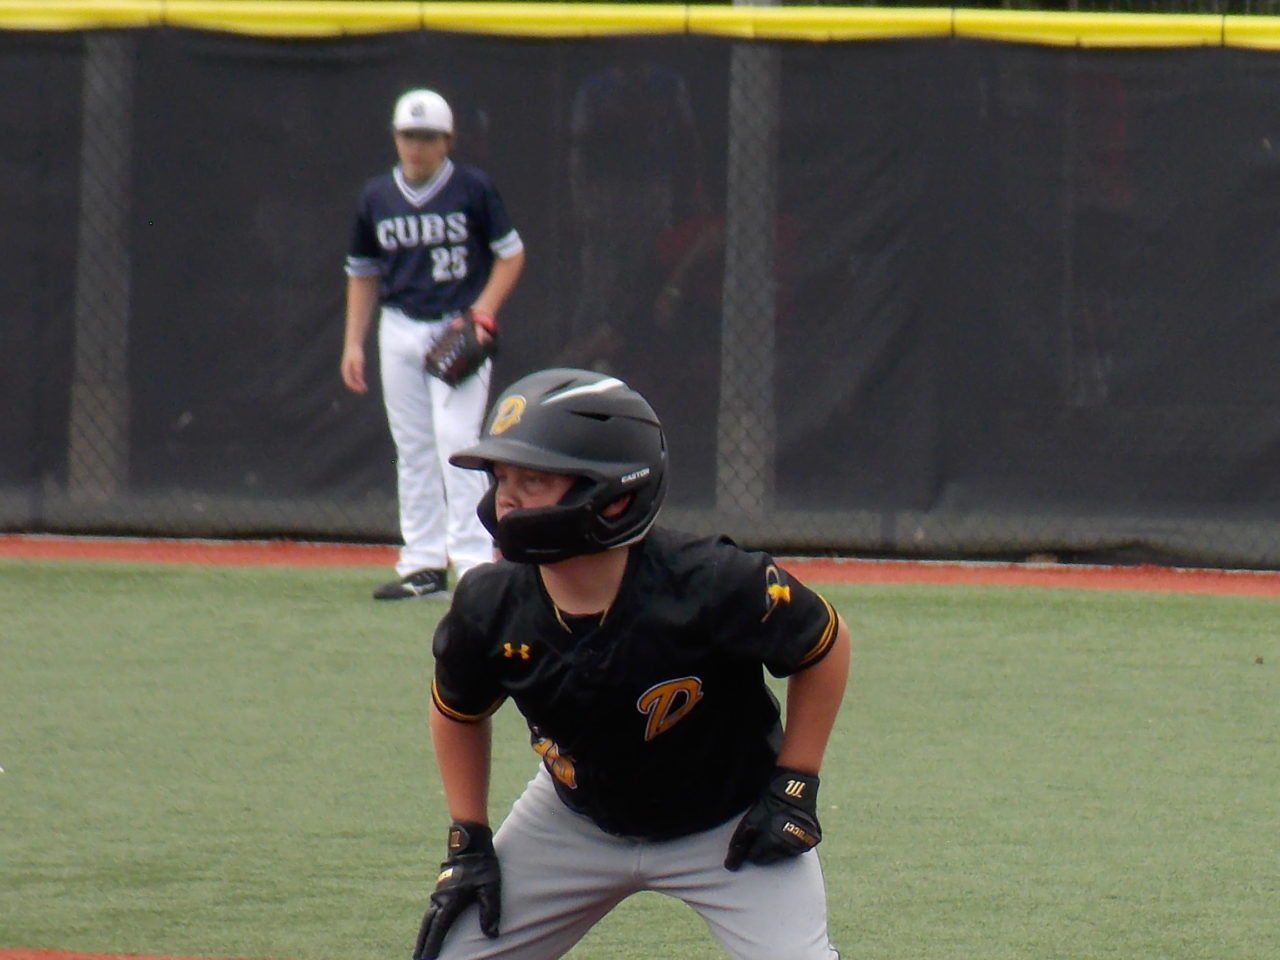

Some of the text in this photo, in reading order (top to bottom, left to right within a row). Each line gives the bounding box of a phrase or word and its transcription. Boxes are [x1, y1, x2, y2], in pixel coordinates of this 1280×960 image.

[377, 212, 468, 251] CUBS
[431, 246, 468, 282] 25
[637, 676, 703, 741] D
